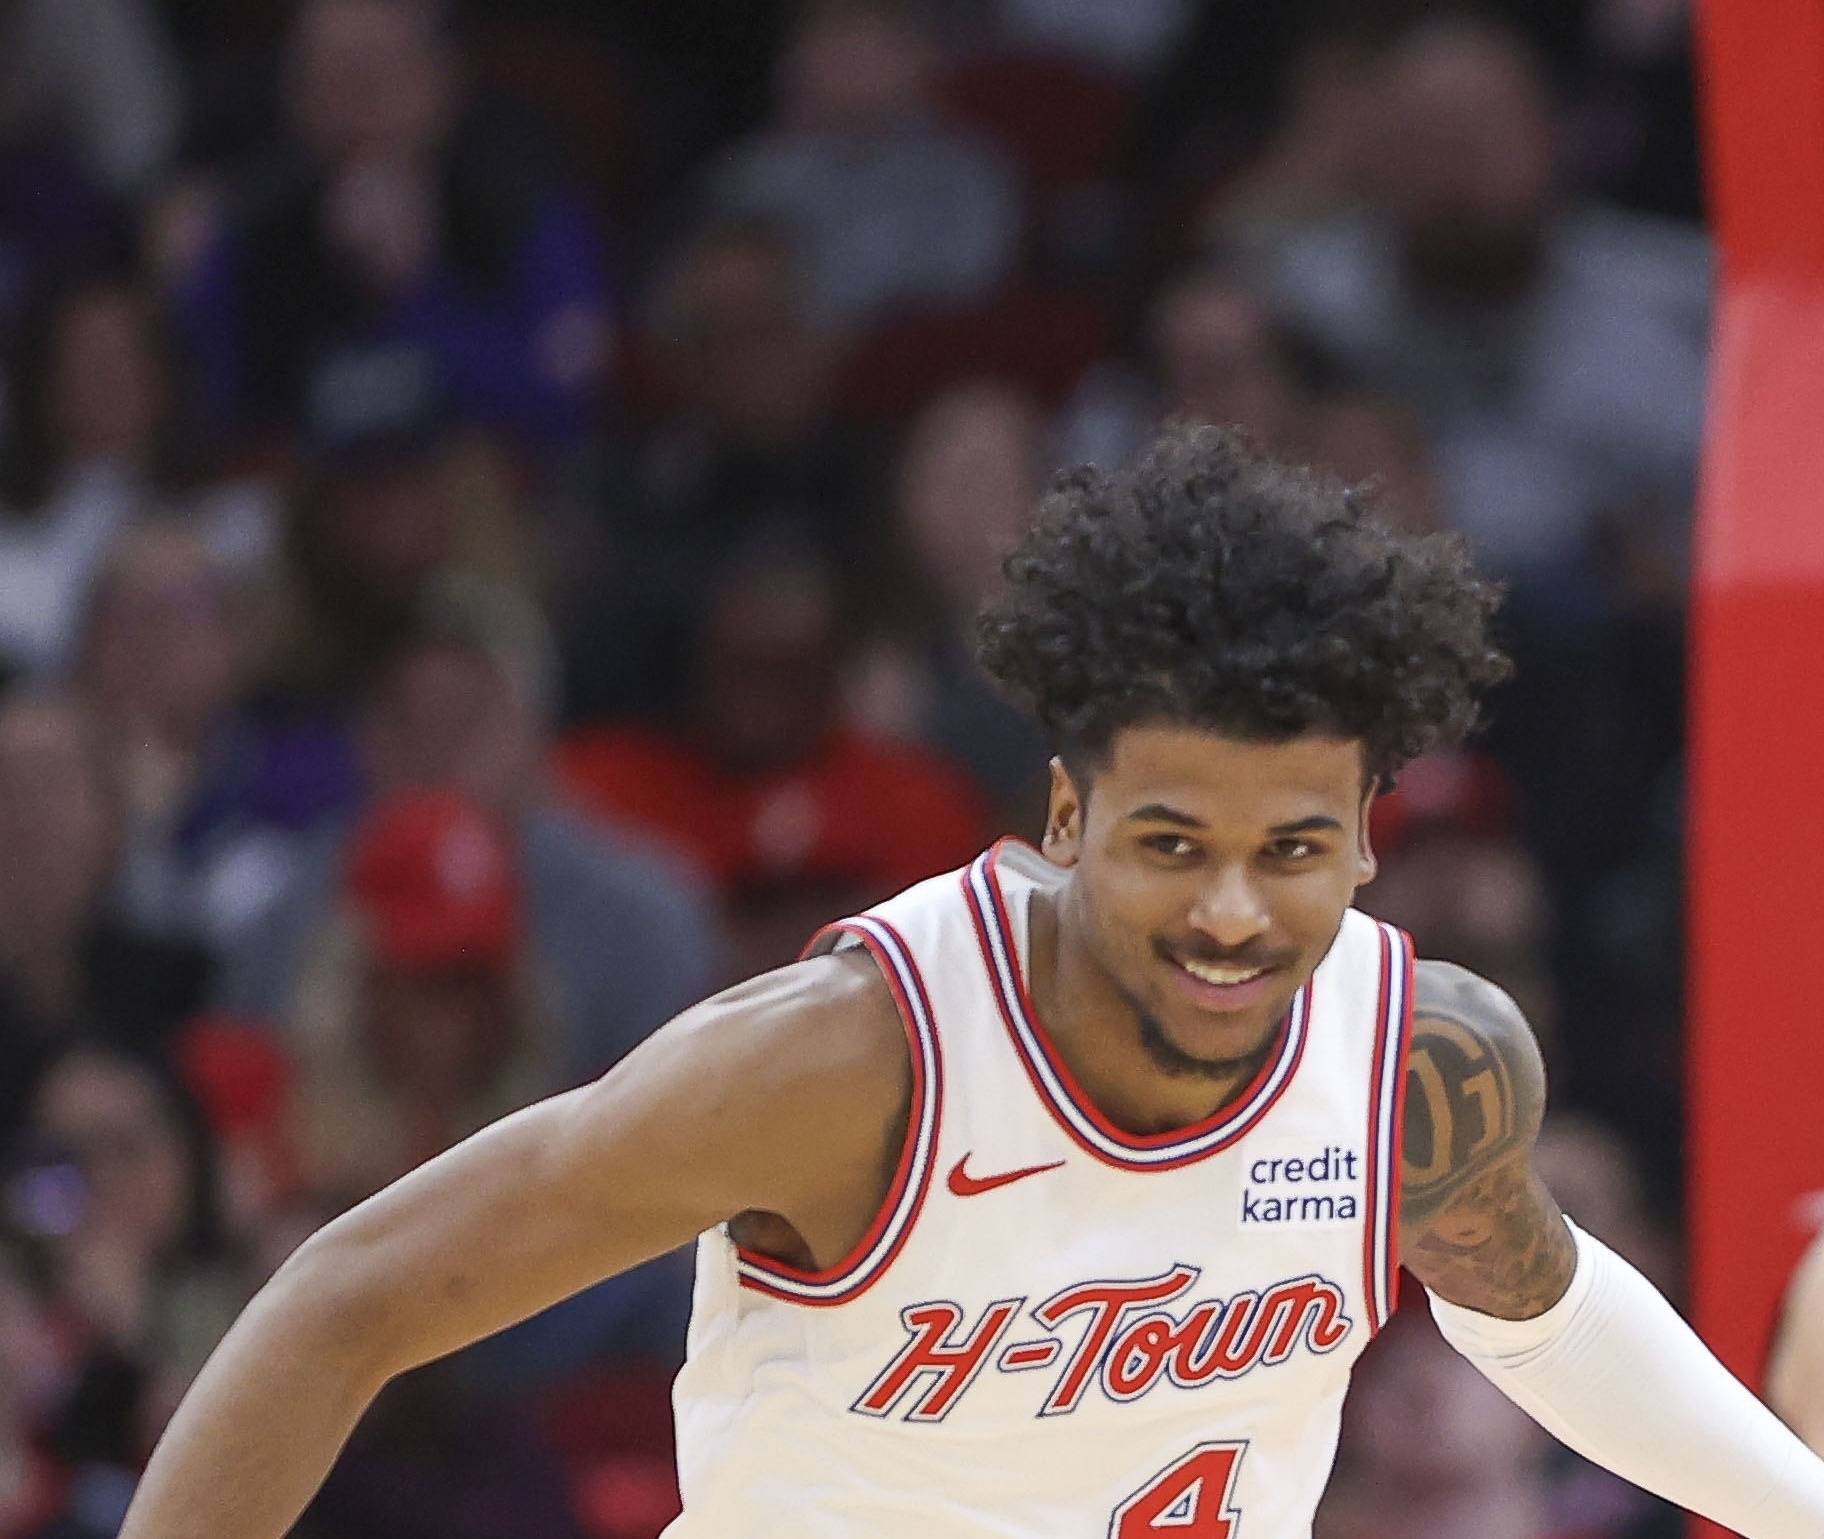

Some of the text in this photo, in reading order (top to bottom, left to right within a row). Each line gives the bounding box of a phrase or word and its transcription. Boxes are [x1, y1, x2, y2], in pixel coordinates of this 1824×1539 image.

[1251, 1147, 1357, 1184] credit
[1242, 1188, 1356, 1223] karma
[850, 1264, 1352, 1423] H-Town
